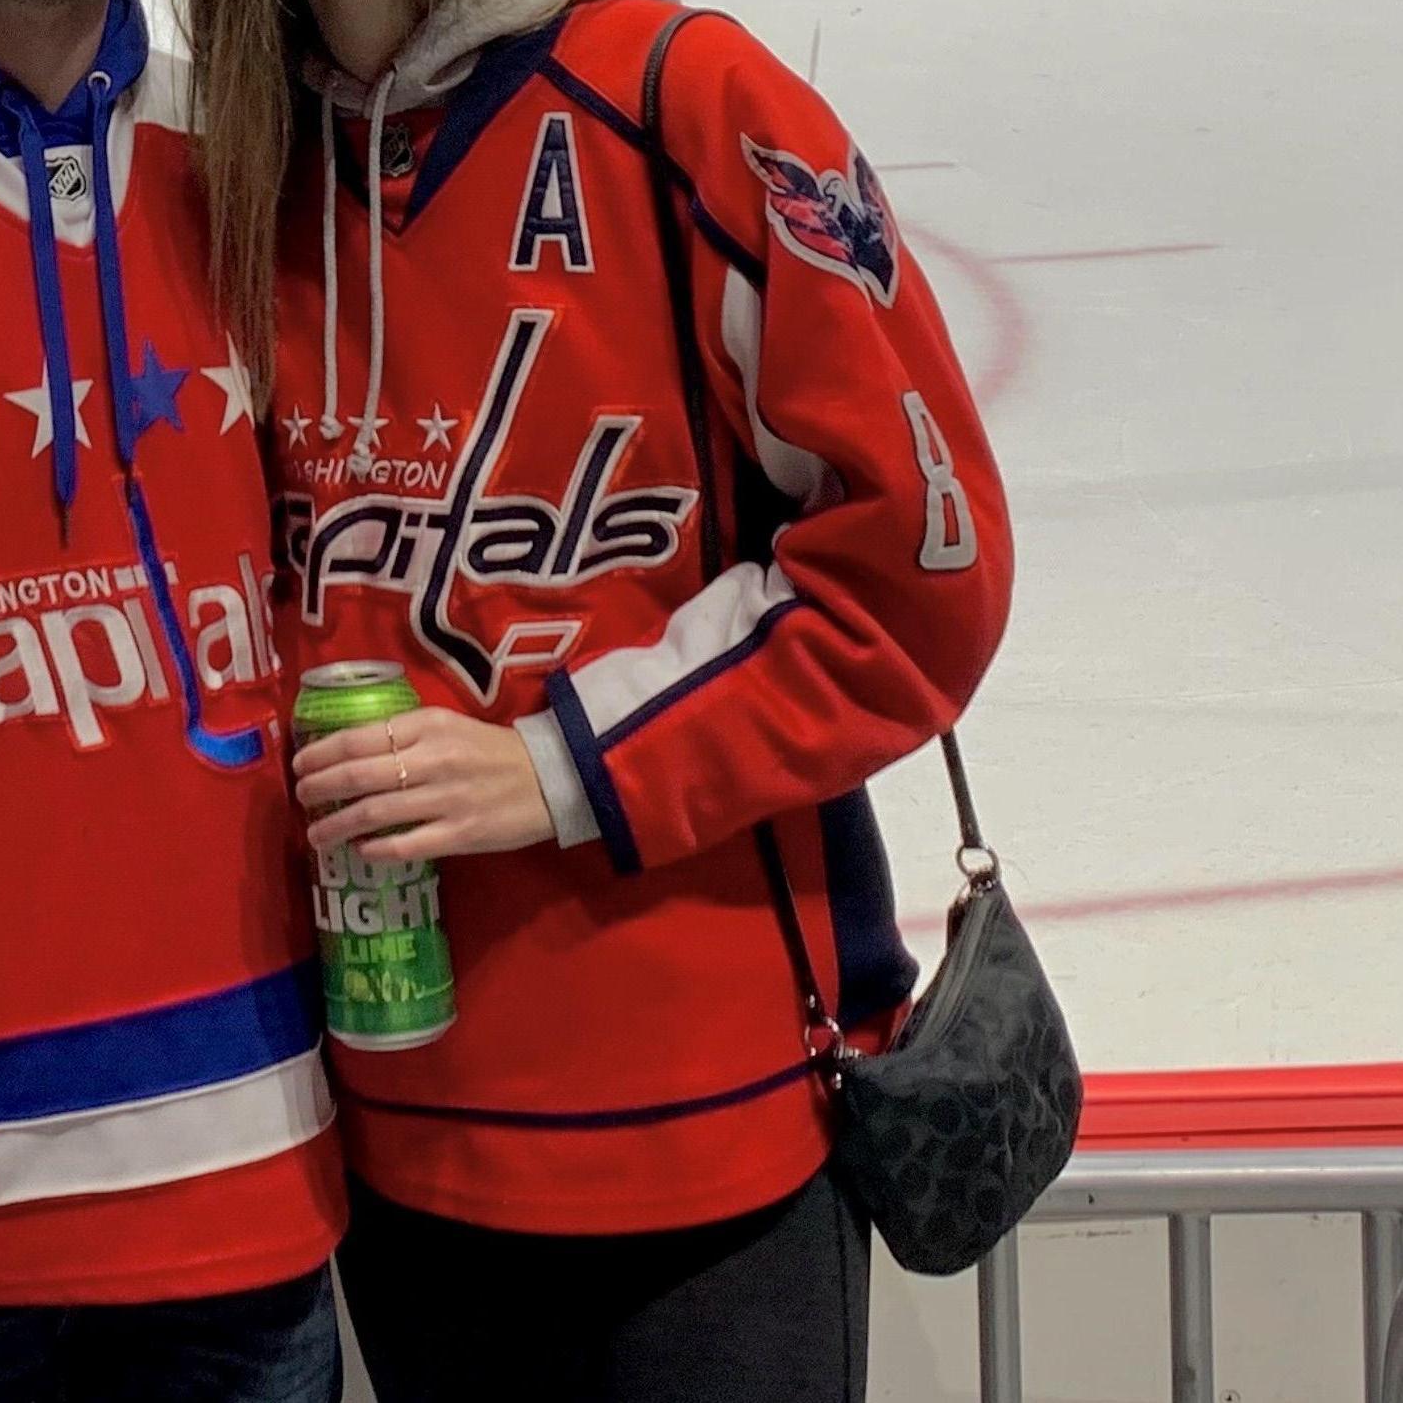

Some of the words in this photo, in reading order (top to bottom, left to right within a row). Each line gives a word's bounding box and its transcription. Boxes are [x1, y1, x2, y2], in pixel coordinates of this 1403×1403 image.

[508, 111, 596, 273] A
[901, 390, 978, 570] 8
[311, 875, 441, 936] LIGHT
[342, 933, 417, 964] LIME
